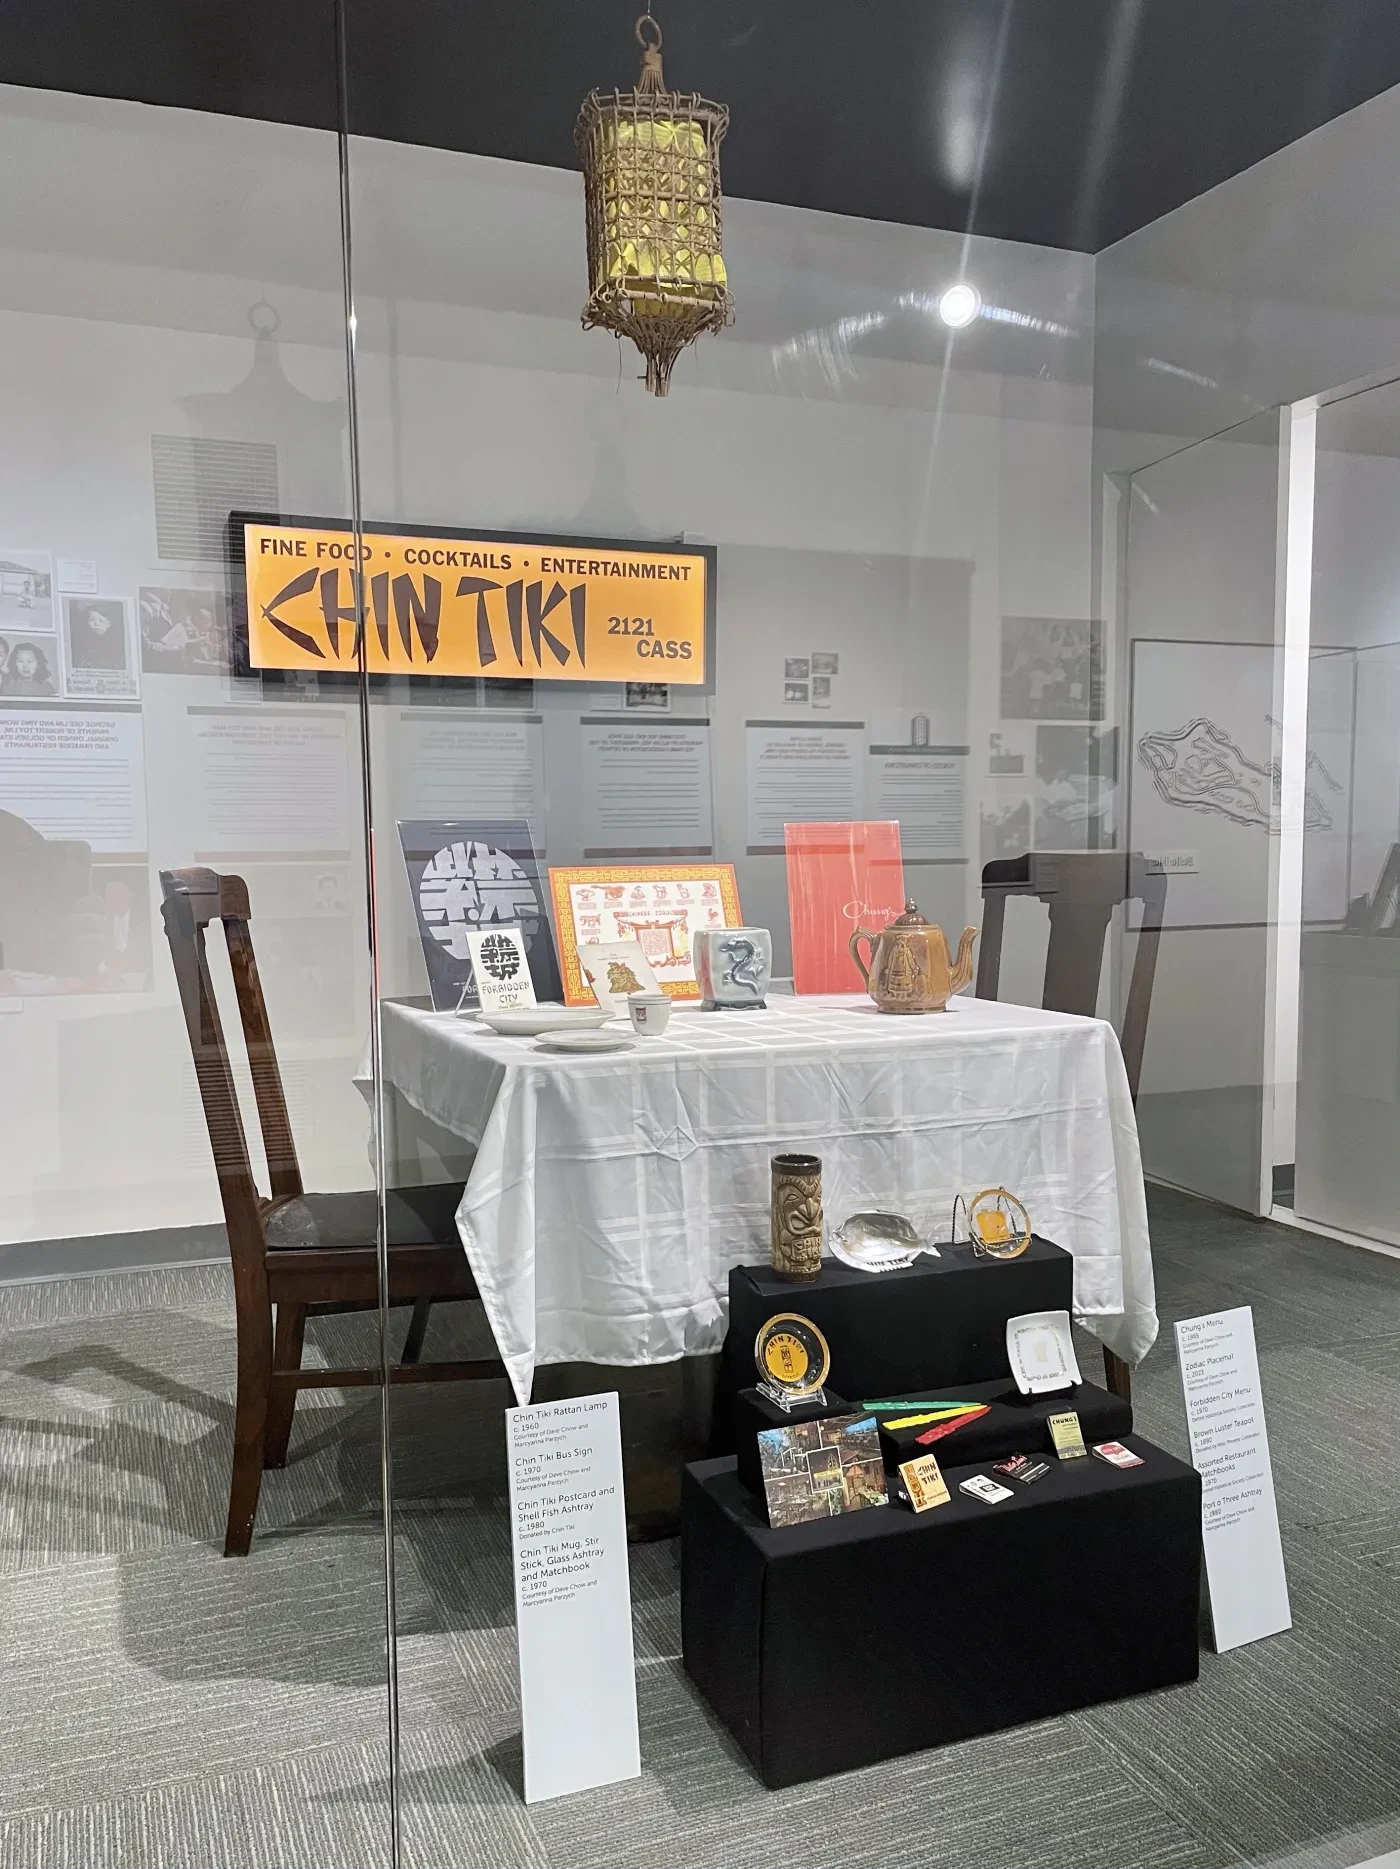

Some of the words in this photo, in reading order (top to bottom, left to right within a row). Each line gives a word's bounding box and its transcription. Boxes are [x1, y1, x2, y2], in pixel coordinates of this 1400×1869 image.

[260, 538, 307, 557] FINE
[316, 541, 372, 561] FOOD
[404, 548, 512, 570] COCKTAILS
[541, 557, 692, 581] ENTERTAINMENT
[259, 566, 442, 664] CHIN
[455, 577, 587, 669] TIKI
[607, 616, 655, 636] 2121
[636, 639, 693, 660] CASS
[482, 981, 530, 995] FORBIDDEN
[499, 993, 518, 1003] CITY
[1206, 1319, 1223, 1327] Menu
[768, 1335, 784, 1356] CHIN
[1185, 1360, 1206, 1370] Zodiac
[1206, 1353, 1235, 1364] Placemat
[1190, 1395, 1220, 1408] Forbidden
[1221, 1391, 1233, 1399] City
[1234, 1387, 1251, 1395] Menu
[513, 1413, 534, 1423] Chin
[536, 1409, 551, 1418] Tiki
[553, 1405, 581, 1416] Rattan
[584, 1401, 608, 1412] Lamp
[521, 1422, 539, 1432] 1960
[1193, 1428, 1214, 1438] Brown
[1215, 1423, 1233, 1433] Luster
[1233, 1416, 1255, 1428] Teapot
[515, 1456, 536, 1467] Chin
[538, 1453, 554, 1463] Tiki
[556, 1451, 572, 1460] Bus
[574, 1447, 593, 1457] Sign
[1198, 1456, 1223, 1469] Assorted
[1225, 1448, 1256, 1461] Restaurant
[524, 1466, 541, 1475] 1970
[921, 1472, 940, 1485] TIKI
[517, 1500, 538, 1511] Chin
[541, 1496, 556, 1506] Tiki
[558, 1490, 597, 1503] Postcard
[598, 1486, 615, 1496] and
[1202, 1501, 1216, 1510] Port
[1222, 1495, 1240, 1504] Three
[1240, 1488, 1263, 1499] Ashtray
[518, 1511, 540, 1522] Shell
[542, 1508, 559, 1518] Fish
[561, 1502, 594, 1514] Ashtray
[519, 1531, 543, 1540] Donated
[520, 1548, 541, 1559] Chin
[543, 1545, 559, 1554] Tiki
[561, 1540, 583, 1550] Mug,
[585, 1536, 599, 1546] Stir
[520, 1560, 544, 1571] Stick,
[547, 1555, 570, 1565] Glass
[572, 1548, 605, 1561] Ashtray
[521, 1572, 538, 1582] and
[540, 1561, 591, 1578] Matchbook
[530, 1580, 547, 1590] 1970
